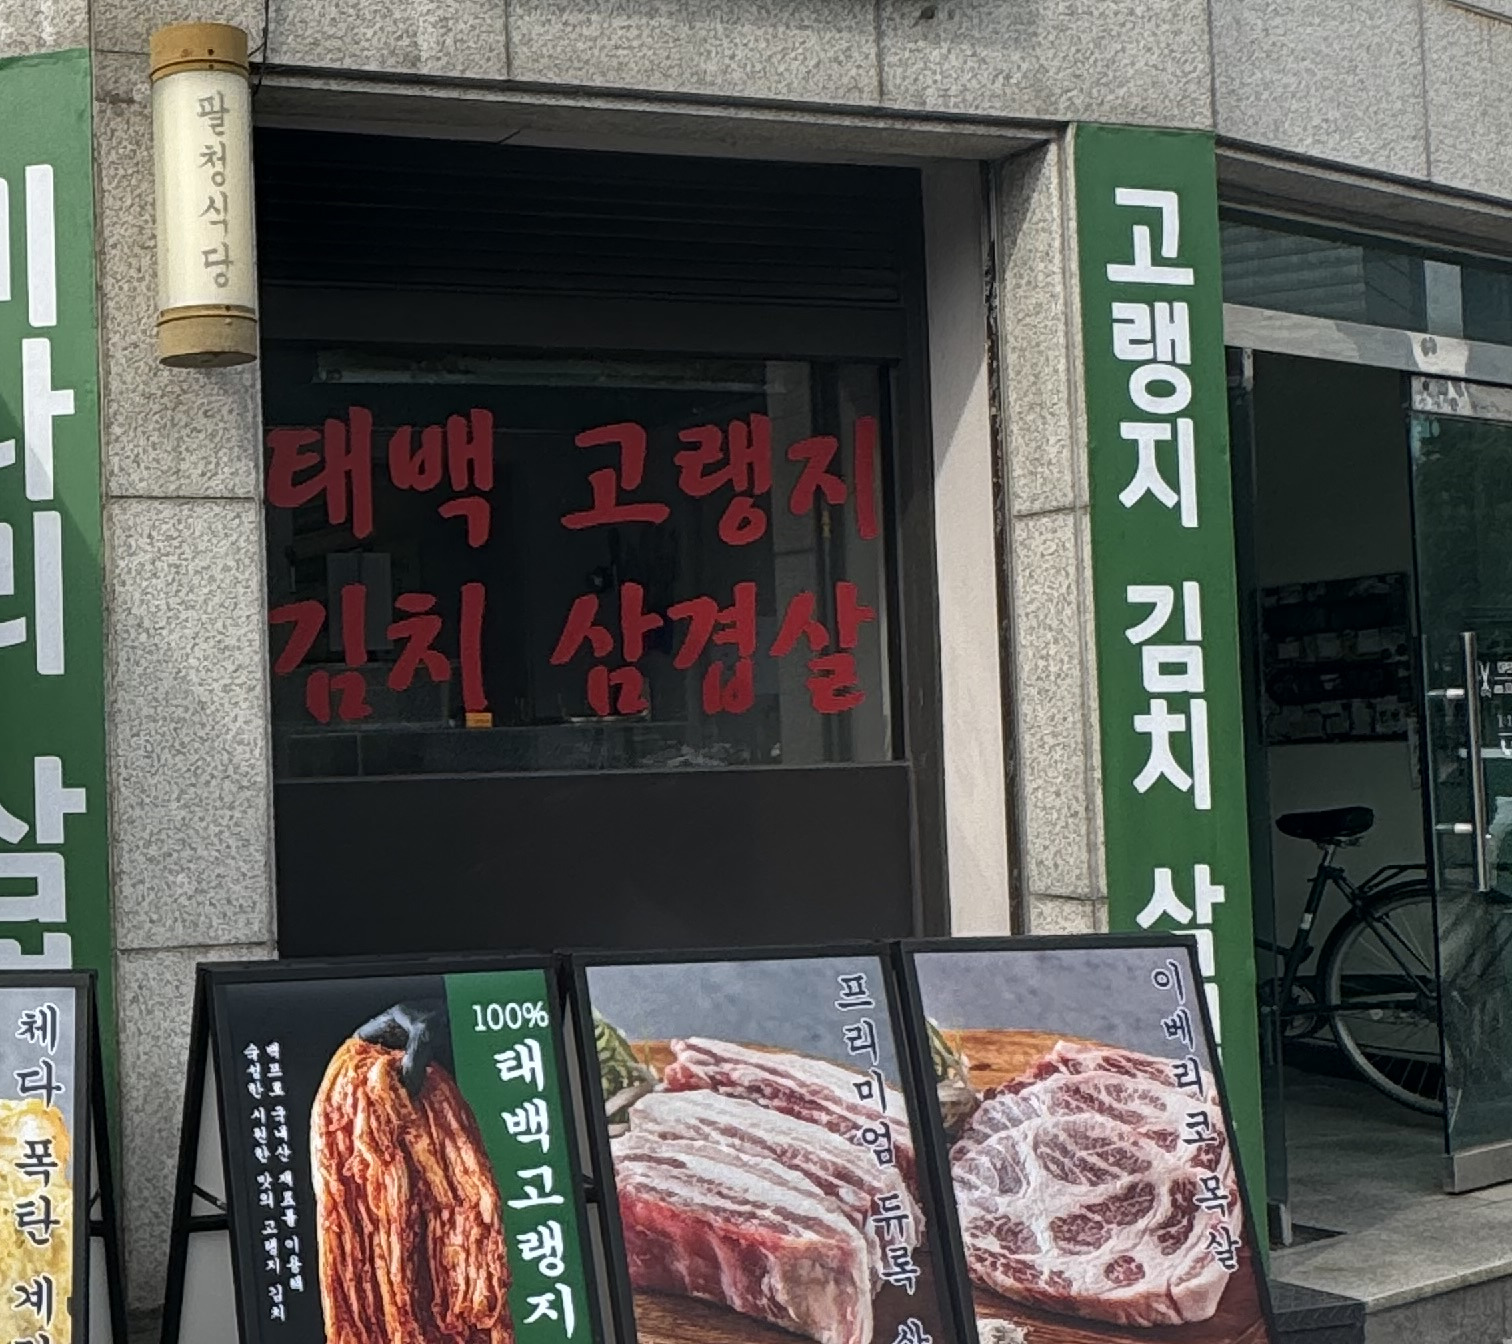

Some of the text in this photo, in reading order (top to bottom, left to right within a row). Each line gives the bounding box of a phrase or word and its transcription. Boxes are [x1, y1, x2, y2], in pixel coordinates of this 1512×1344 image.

[195, 89, 235, 289] 팔청식당
[1105, 187, 1200, 528] 고랭지
[264, 406, 880, 548] 태백 고랭지
[269, 581, 879, 723] 김치 삼겹살
[1124, 580, 1212, 811] 김치
[14, 1002, 64, 1110] 체다
[471, 1000, 551, 1034] 100%
[834, 971, 896, 1168] 프리미엄
[869, 1190, 922, 1298] 듀록
[1150, 958, 1241, 1274] 이베리코 목살
[12, 1137, 62, 1248] 폭탄
[267, 1282, 286, 1323] 김치
